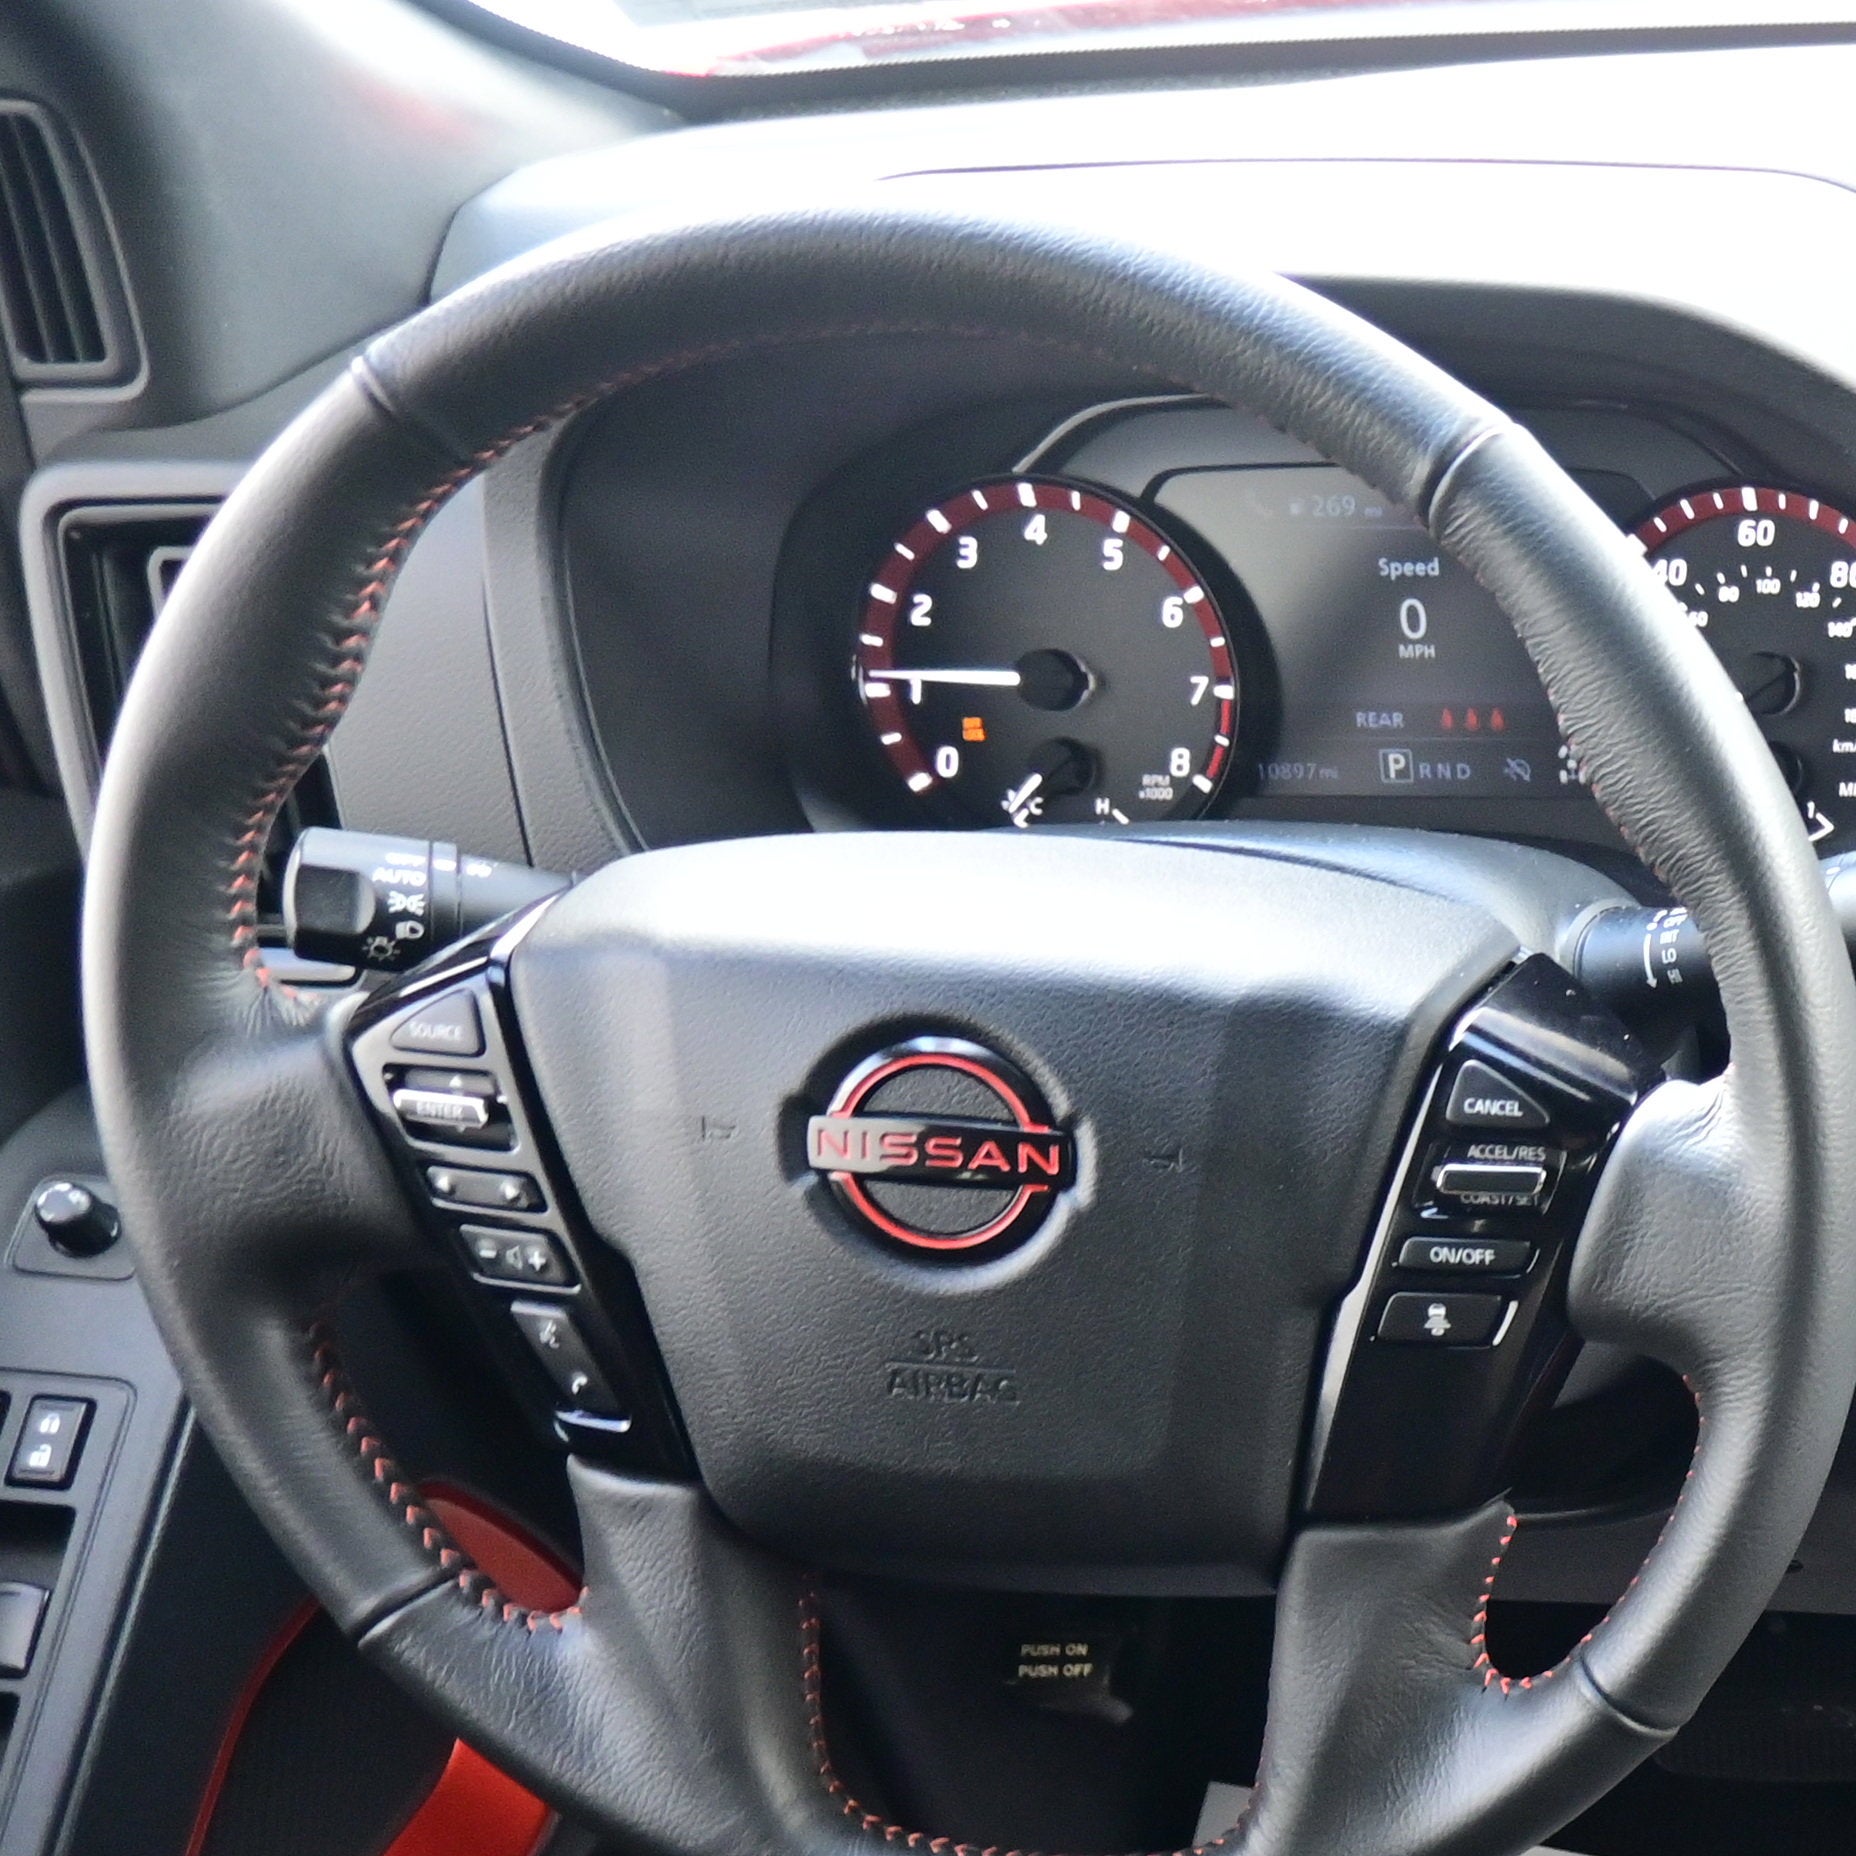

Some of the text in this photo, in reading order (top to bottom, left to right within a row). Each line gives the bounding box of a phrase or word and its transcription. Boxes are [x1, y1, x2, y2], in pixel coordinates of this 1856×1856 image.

[1312, 495, 1356, 517] 269
[1023, 514, 1048, 546] 4
[1738, 519, 1775, 547] 60
[956, 536, 979, 570] 3
[1102, 538, 1125, 571] 5
[1378, 556, 1440, 581] Speed
[1755, 579, 1781, 595] 100
[910, 593, 933, 627] 2
[1161, 596, 1185, 629] 6
[1400, 597, 1428, 640] 0
[1399, 644, 1436, 660] MPH
[1189, 676, 1210, 706] 7
[1356, 711, 1405, 729] REAR
[935, 745, 960, 778] 0
[1169, 747, 1191, 778] 8
[1388, 753, 1472, 779] P R N D
[1141, 773, 1171, 787] RPM
[1095, 797, 1110, 816] H
[371, 866, 428, 888] AUTO
[408, 1021, 465, 1042] SOURCE
[1463, 1096, 1524, 1118] CANCEL
[816, 1127, 1062, 1176] NISSAN
[1467, 1143, 1547, 1163] ACCEL/RES
[1429, 1246, 1496, 1267] ON/OFF
[1020, 1642, 1089, 1658] PUSH ON
[1017, 1662, 1094, 1679] PUSH OFF
